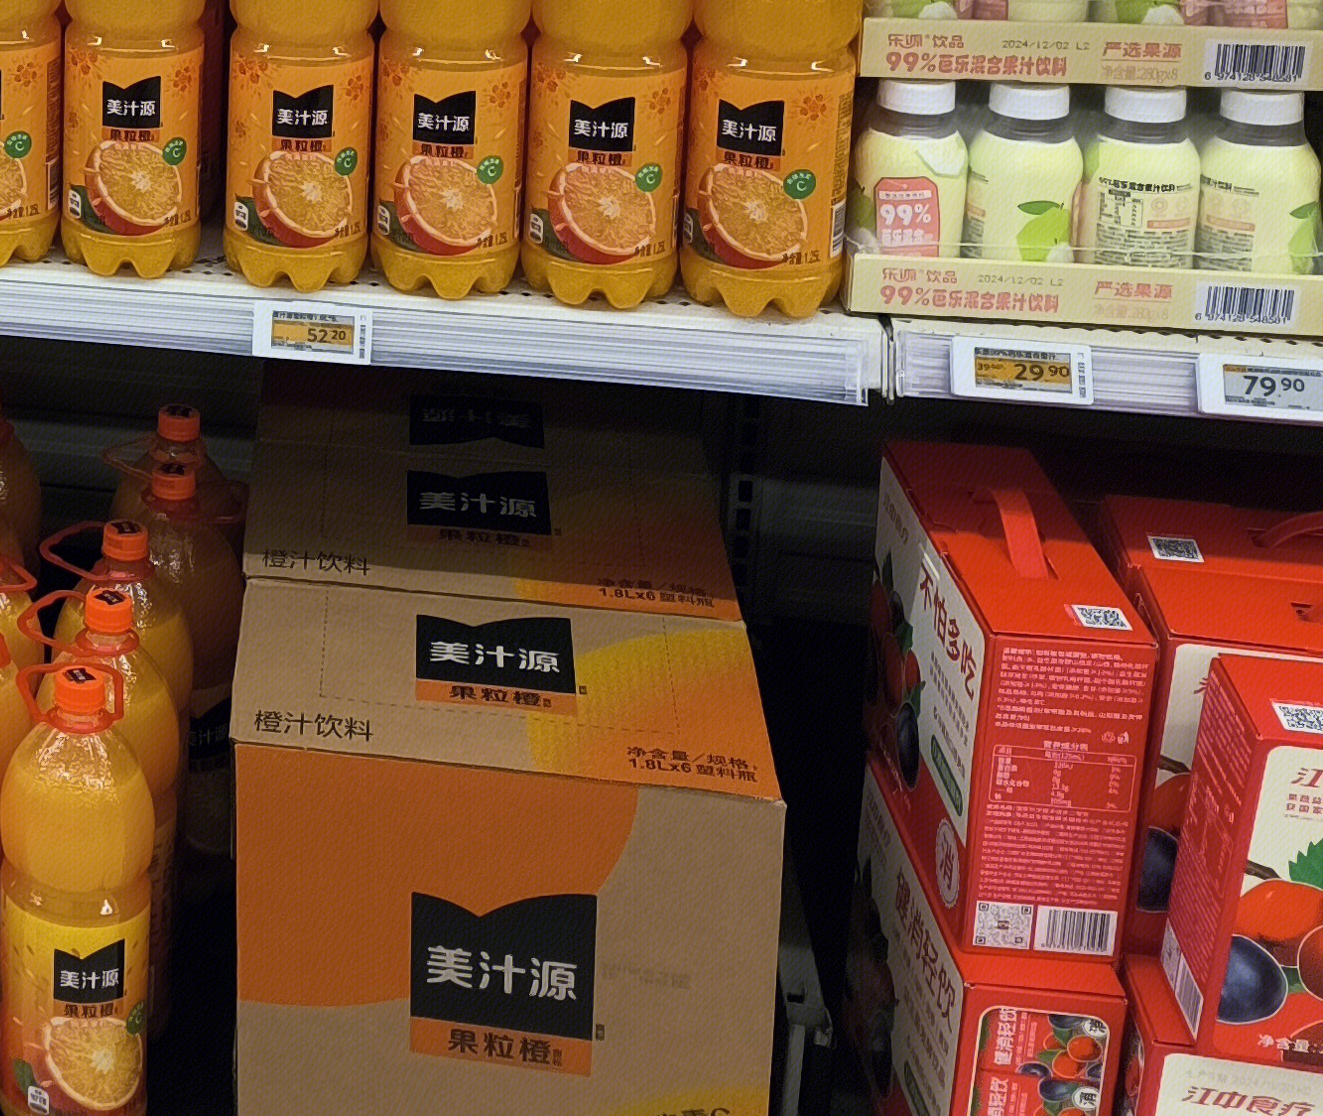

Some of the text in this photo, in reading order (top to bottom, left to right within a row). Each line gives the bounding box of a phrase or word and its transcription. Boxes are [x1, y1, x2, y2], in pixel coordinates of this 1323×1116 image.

[1001, 39, 1069, 51] 2024/12/02
[1102, 41, 1183, 60] 严选果源
[106, 98, 156, 117] 美汁源
[275, 107, 329, 126] 美汁源
[417, 113, 470, 133] 美汁源
[573, 119, 629, 140] 美汁源
[721, 118, 777, 143] 美汁源
[879, 203, 931, 226] 99%
[1094, 280, 1174, 300] 严选果源
[306, 327, 347, 345] 52.20
[1013, 363, 1070, 382] 29.90
[1242, 374, 1306, 398] 79.90
[419, 490, 538, 519] 美汁源
[261, 548, 371, 577] 橙汁饮料
[918, 564, 978, 702] 不怕多吃
[429, 640, 562, 674] 美汁源
[448, 684, 542, 707] 果粒橙
[253, 709, 374, 743] 橙汁饮料
[59, 967, 121, 991] 美汁源
[426, 944, 579, 1002] 美汁源
[447, 1027, 553, 1066] 果粒橙
